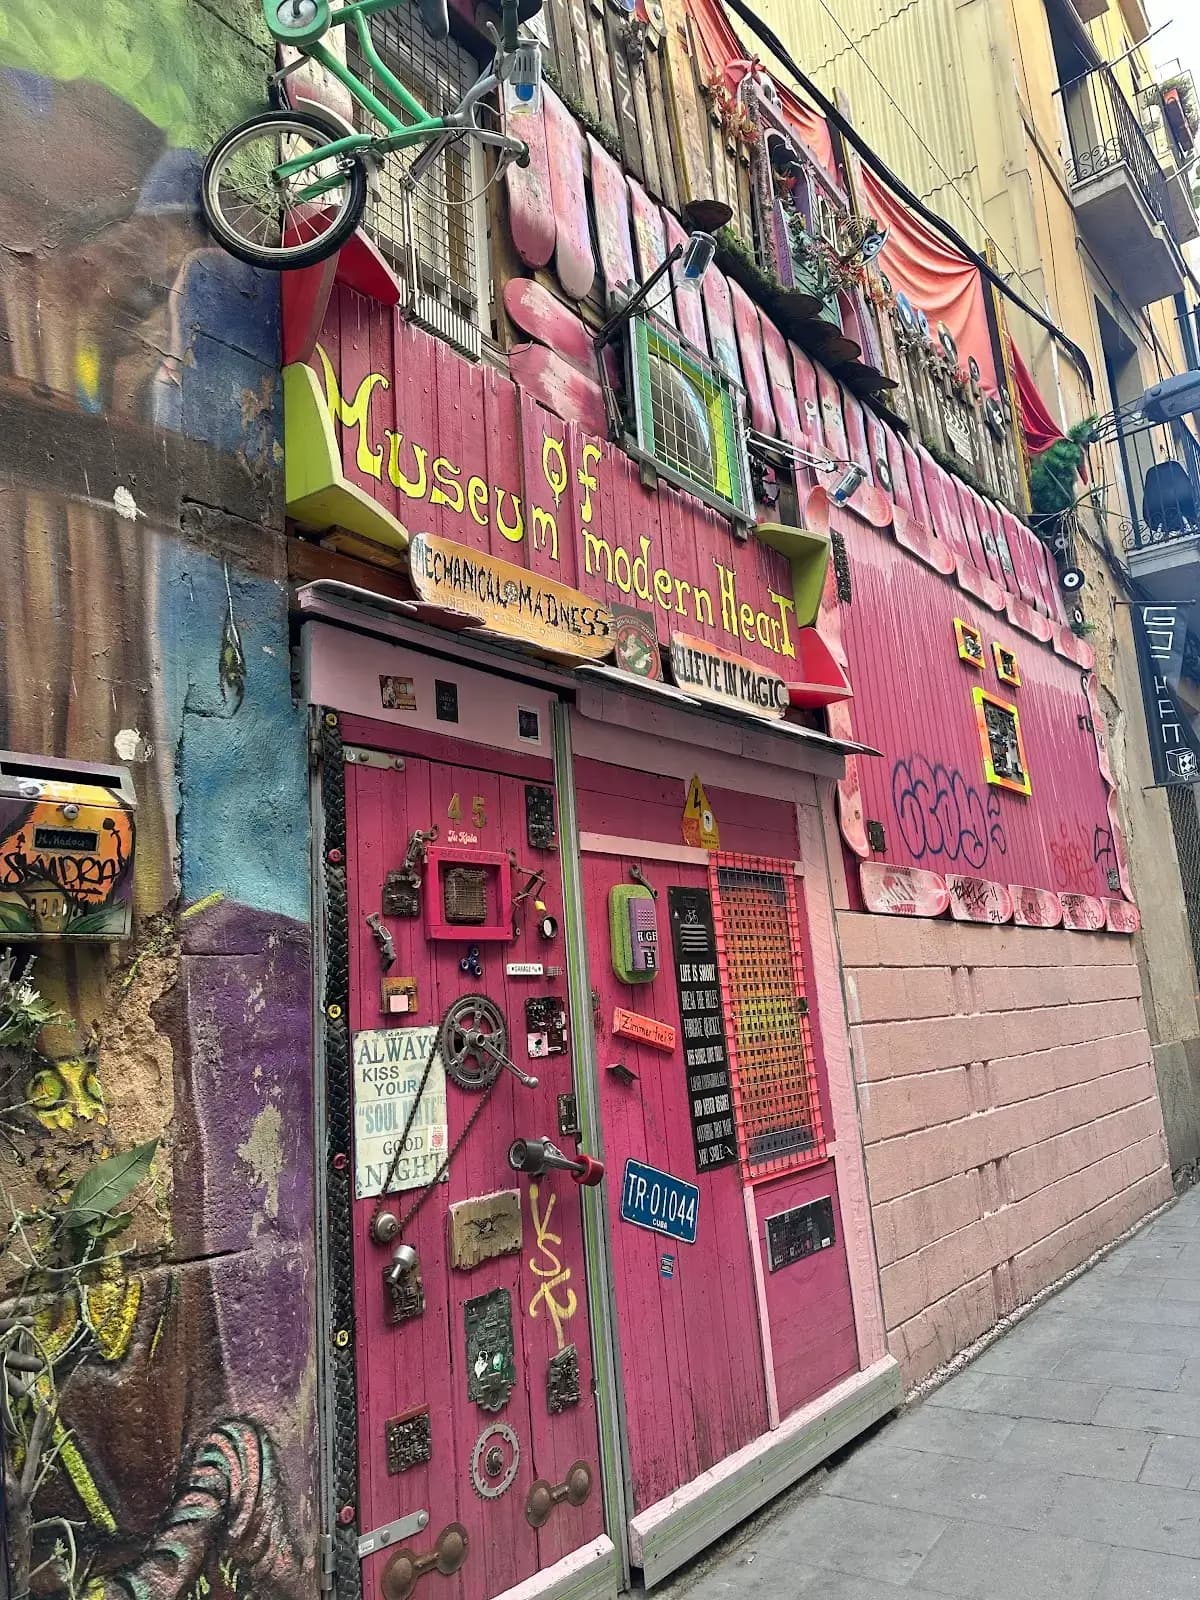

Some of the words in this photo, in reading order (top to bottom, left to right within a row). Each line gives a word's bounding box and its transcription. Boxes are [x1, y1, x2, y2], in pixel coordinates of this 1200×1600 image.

[315, 341, 560, 561] Museum
[411, 537, 508, 608] MECHANICAL
[517, 584, 611, 637] MADNESS
[581, 527, 715, 629] modern
[670, 641, 722, 693] BELIEVE
[723, 660, 738, 697] IN
[739, 665, 788, 713] MAGIC
[680, 964, 692, 982] LIFE
[362, 1066, 399, 1083] KISS
[374, 1080, 417, 1097] YOUR
[383, 1137, 424, 1156] GOOD
[652, 1218, 668, 1231] CUBA
